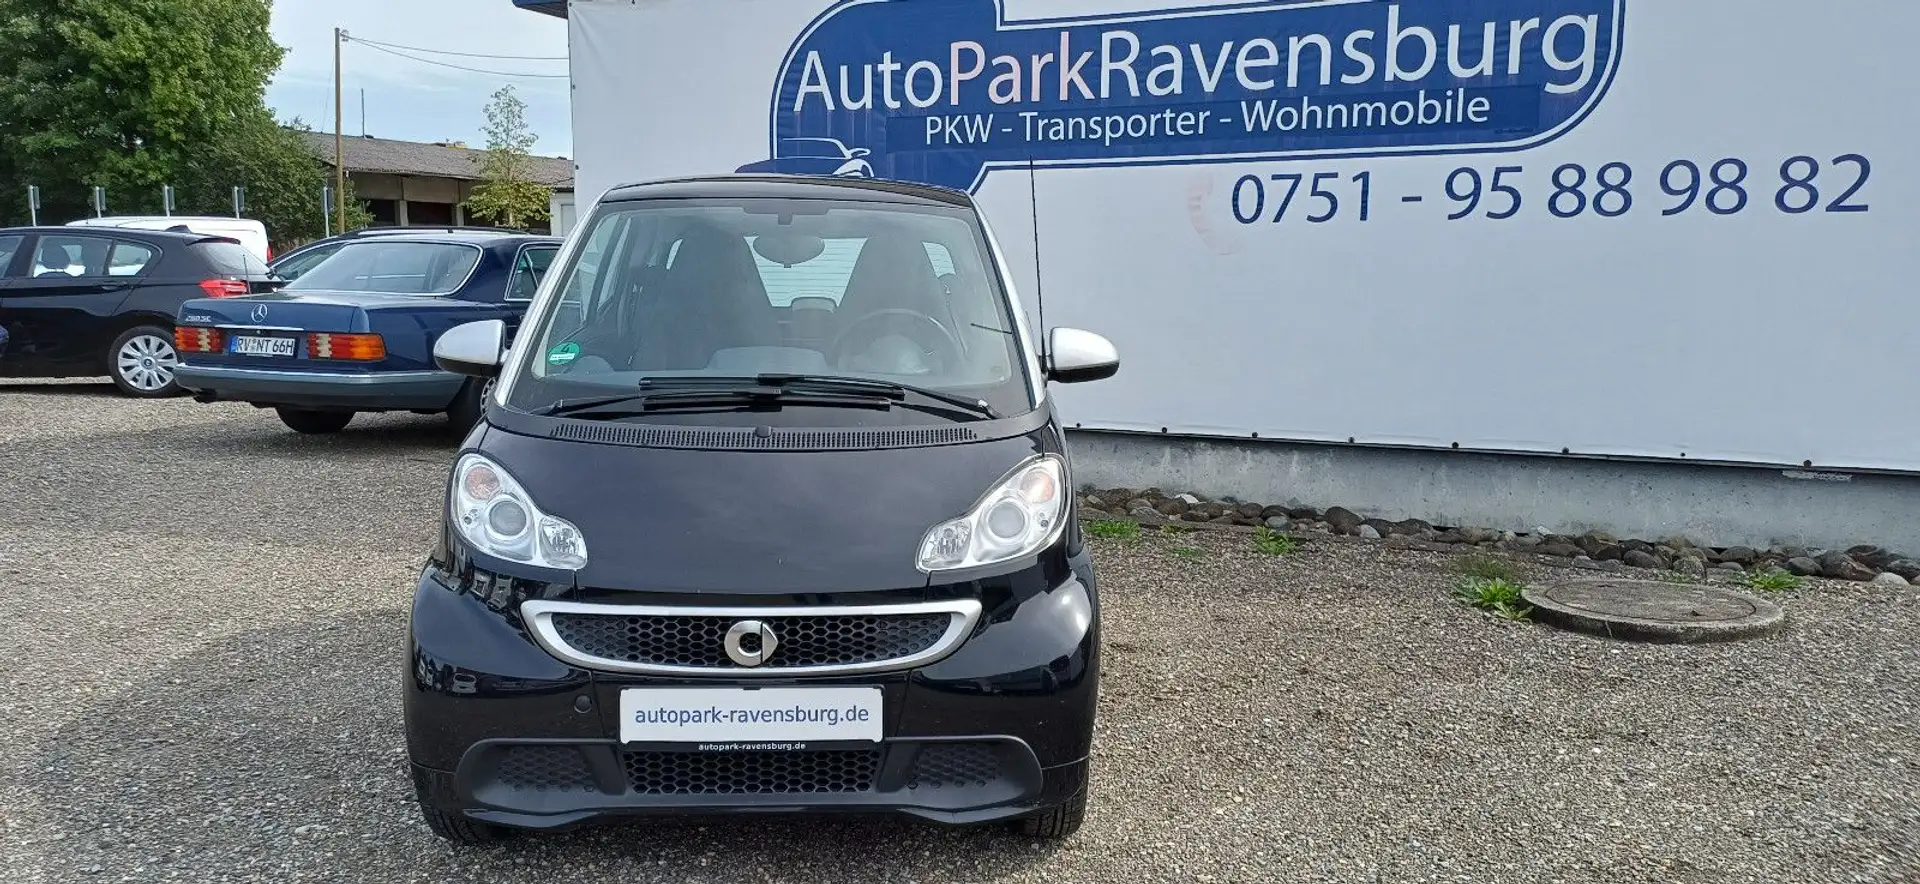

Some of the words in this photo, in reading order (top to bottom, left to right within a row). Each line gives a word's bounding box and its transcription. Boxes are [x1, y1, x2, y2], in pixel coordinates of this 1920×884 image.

[793, 5, 1598, 112] AutoParkRavensburg
[926, 113, 994, 145] PKW
[1019, 108, 1211, 146] Transporter
[1240, 87, 1490, 133] Wohnmobile
[1231, 170, 1371, 224] 0751
[1444, 166, 1523, 220] 95
[1547, 161, 1633, 218] 88
[1658, 158, 1748, 216] 98
[1774, 153, 1871, 213] 82
[272, 340, 294, 354] 66H
[561, 344, 570, 353] 4
[635, 704, 869, 727] autopark-ravensburg.de
[698, 742, 806, 752] autopark-ravensburg.de
